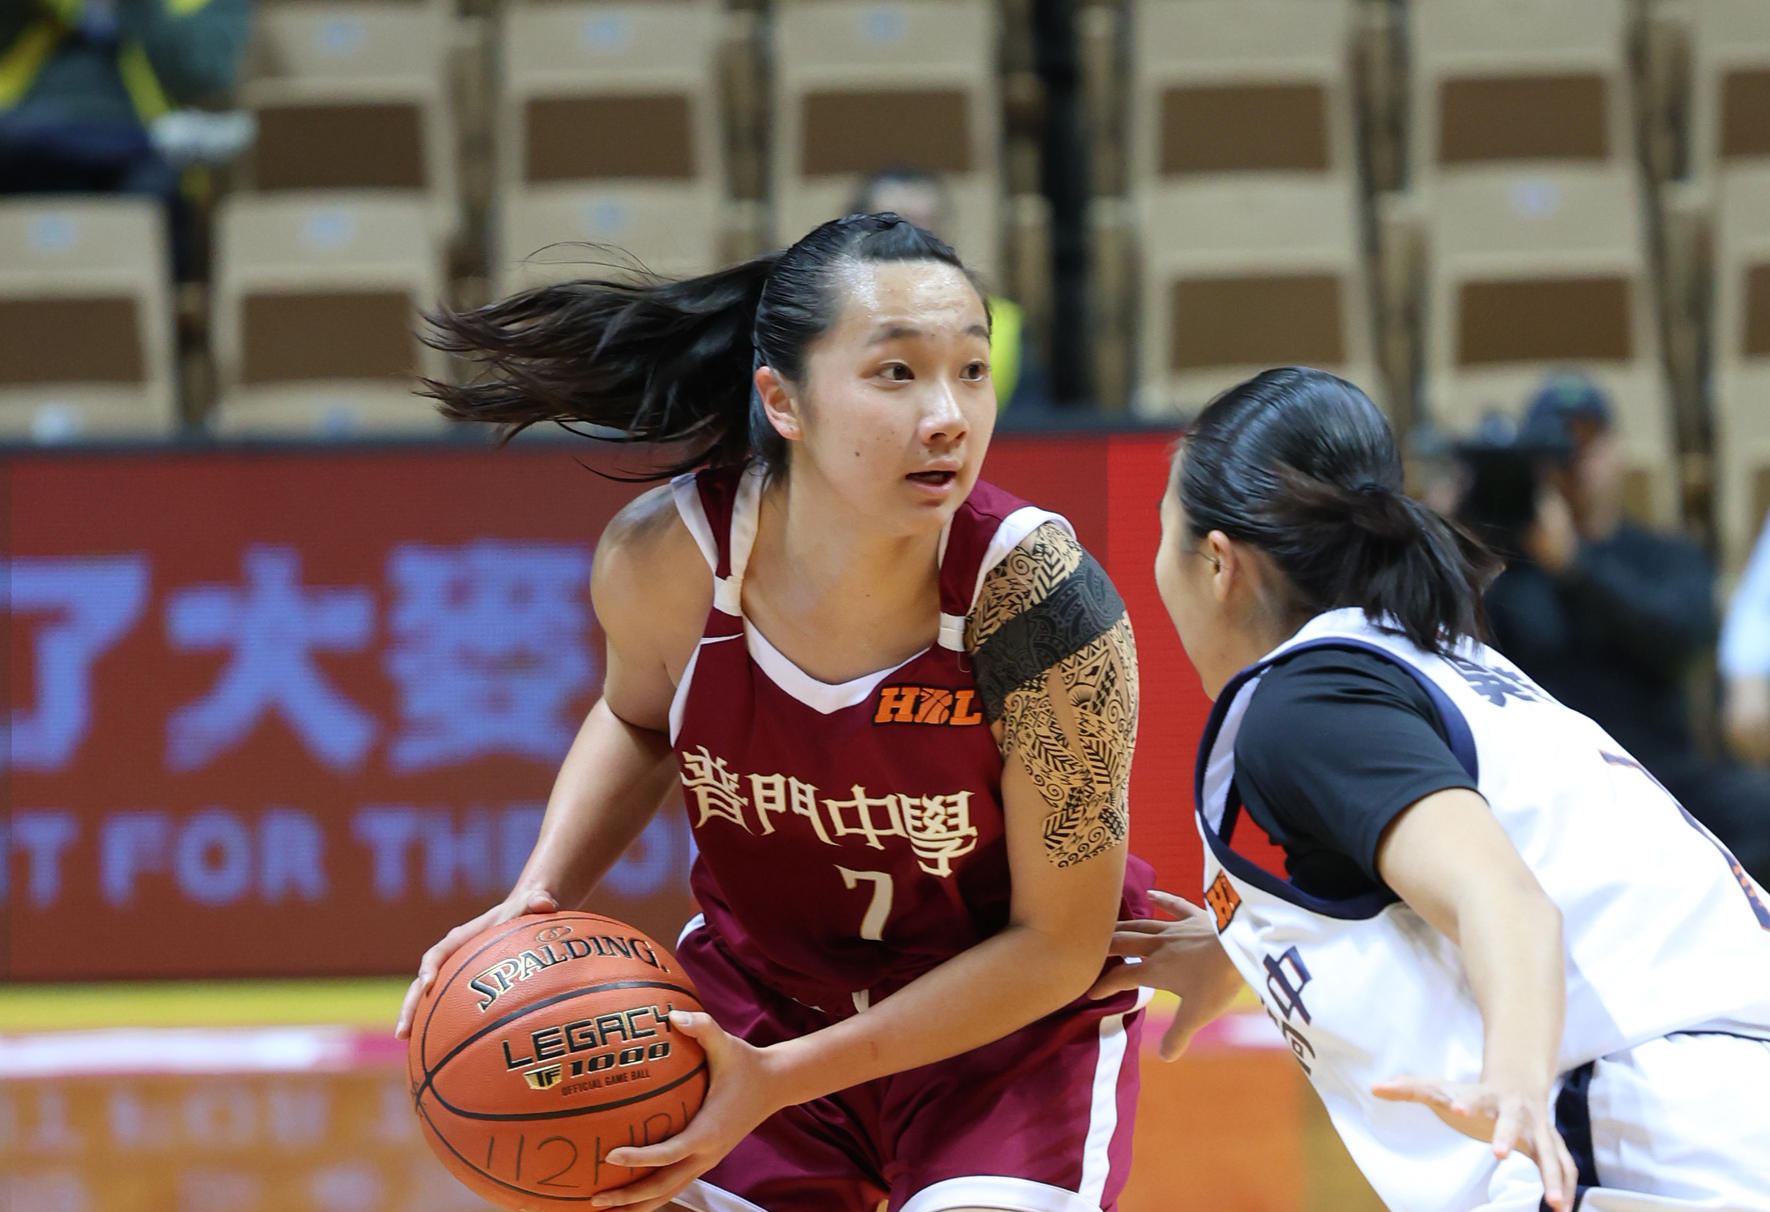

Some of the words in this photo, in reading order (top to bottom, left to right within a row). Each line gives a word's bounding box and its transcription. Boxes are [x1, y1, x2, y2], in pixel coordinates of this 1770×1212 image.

[874, 685, 983, 727] HBL
[680, 744, 979, 879] 普門中學
[102, 809, 325, 906] FOR
[833, 864, 894, 942] 7
[470, 935, 668, 1014] SPALDING
[502, 1003, 672, 1073] LEGACY
[523, 1064, 563, 1091] TF
[569, 1041, 671, 1079] 1000
[561, 1079, 602, 1097] OFFICIAL
[604, 1072, 630, 1087] GAME
[630, 1069, 651, 1082] BALL
